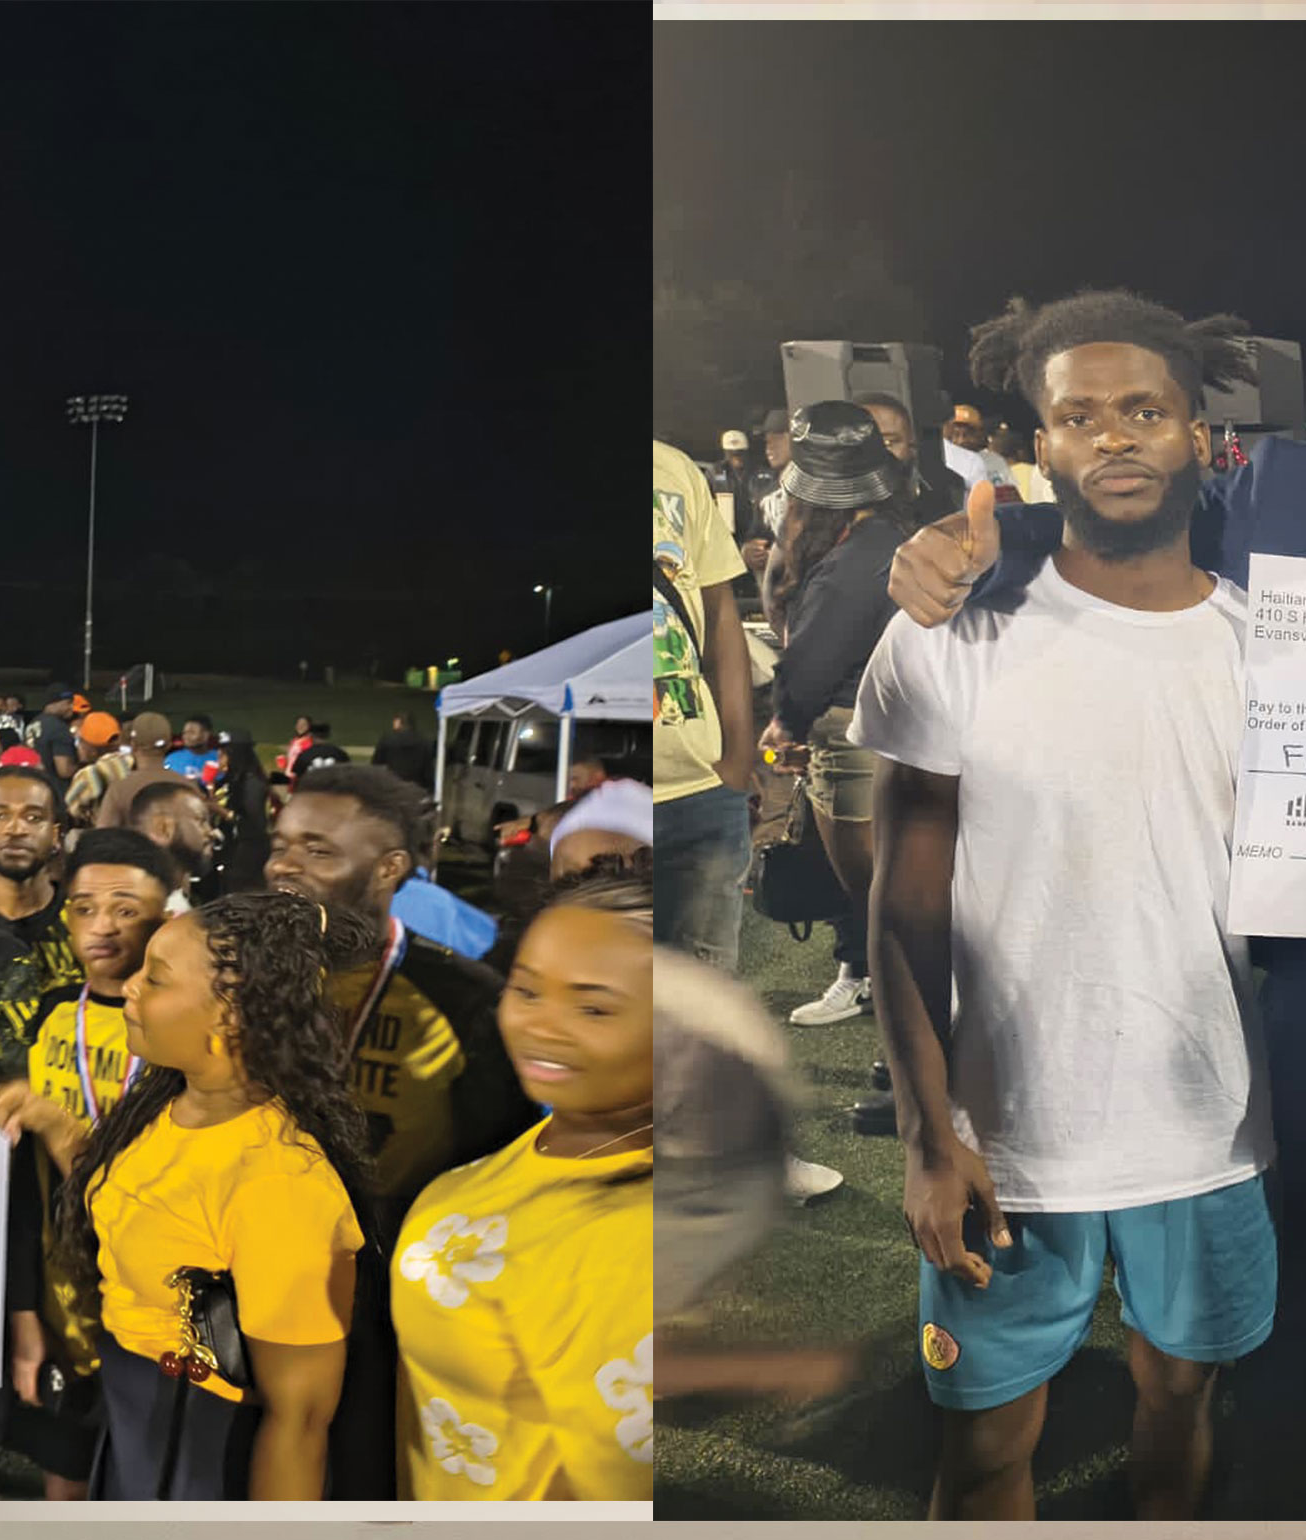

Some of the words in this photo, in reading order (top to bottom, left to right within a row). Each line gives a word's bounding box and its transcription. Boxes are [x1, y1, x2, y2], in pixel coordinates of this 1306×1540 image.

[1256, 609, 1283, 622] 410
[1287, 610, 1298, 623] S
[1248, 700, 1275, 715] Pay
[1279, 701, 1292, 714] to
[1247, 717, 1286, 730] Order
[1291, 719, 1305, 731] of
[1236, 845, 1283, 859] MEMO
